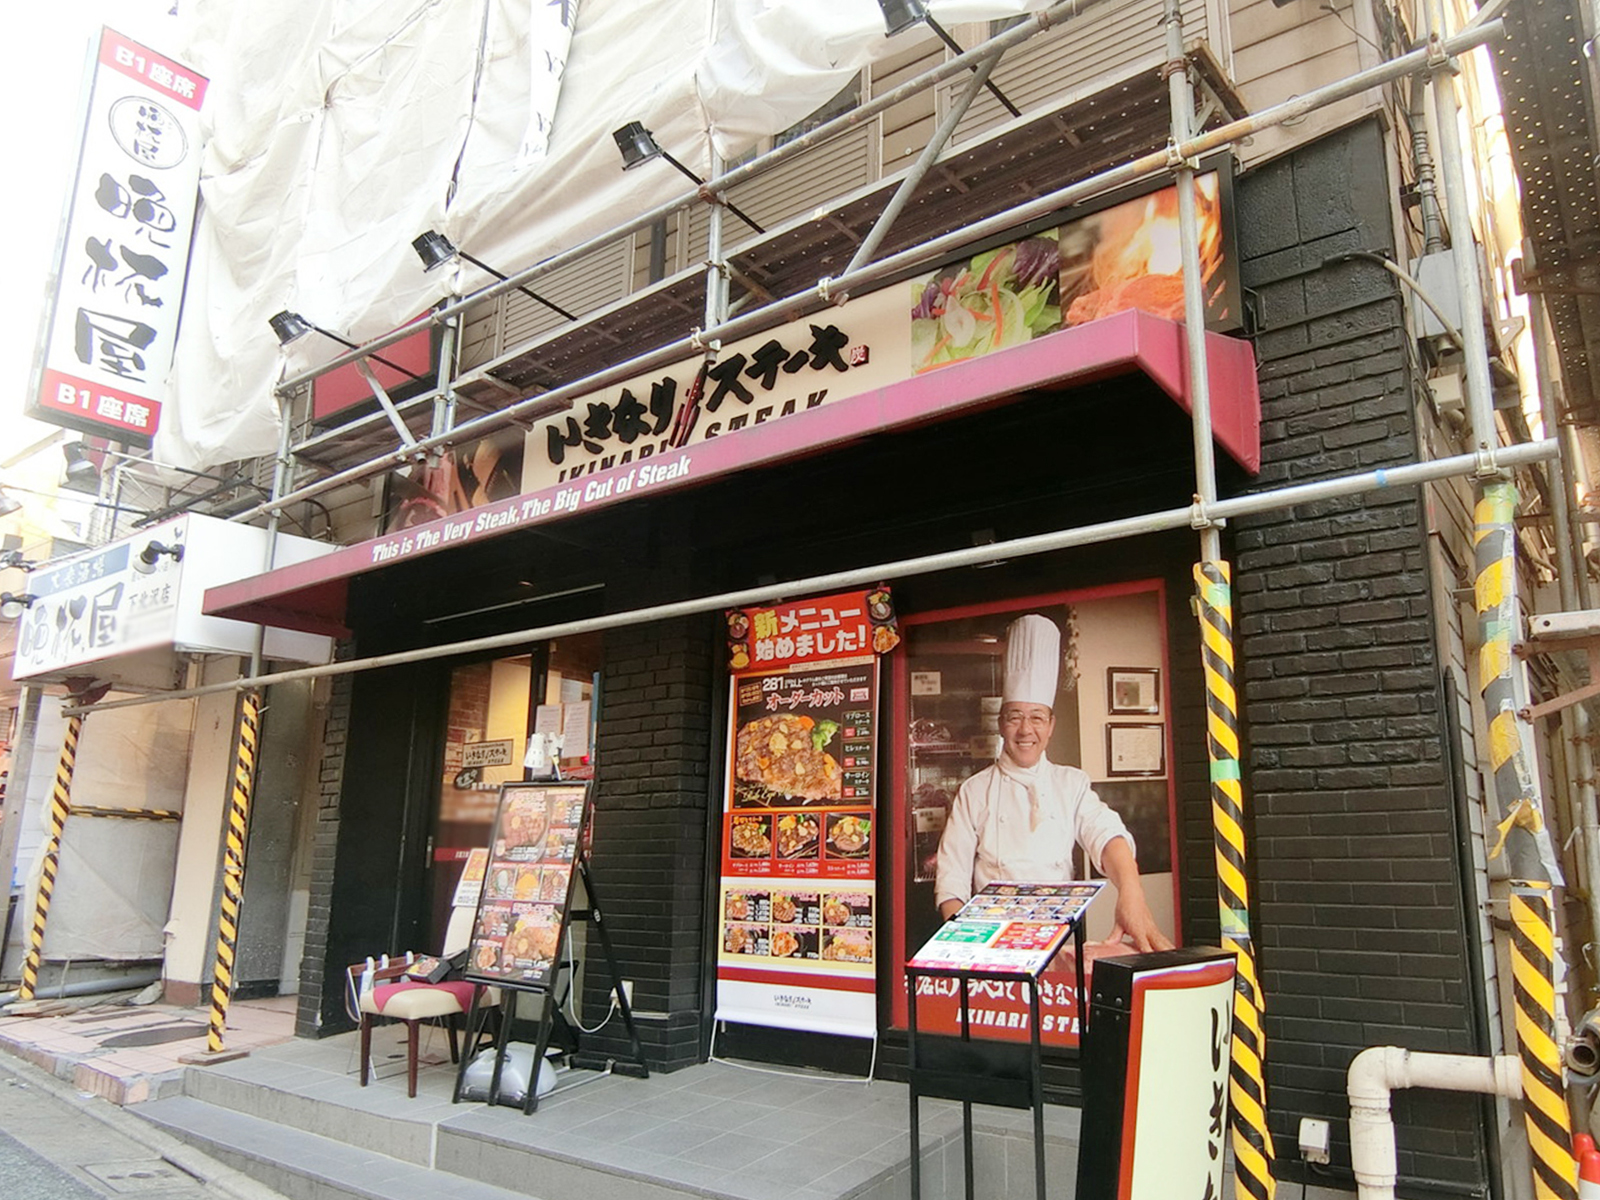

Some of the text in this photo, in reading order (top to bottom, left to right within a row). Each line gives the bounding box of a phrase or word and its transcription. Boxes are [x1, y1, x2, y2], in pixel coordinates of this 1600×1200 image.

[57, 383, 151, 428] B1座席
[372, 541, 399, 562] This
[400, 536, 412, 554] is
[415, 528, 440, 548] The
[443, 519, 473, 543] Very
[553, 488, 580, 514] Big
[584, 482, 613, 503] Cut
[615, 472, 634, 493] of
[637, 456, 693, 488] Steak
[753, 608, 861, 640] 新メニュー
[955, 1008, 1028, 1029] IKINARI
